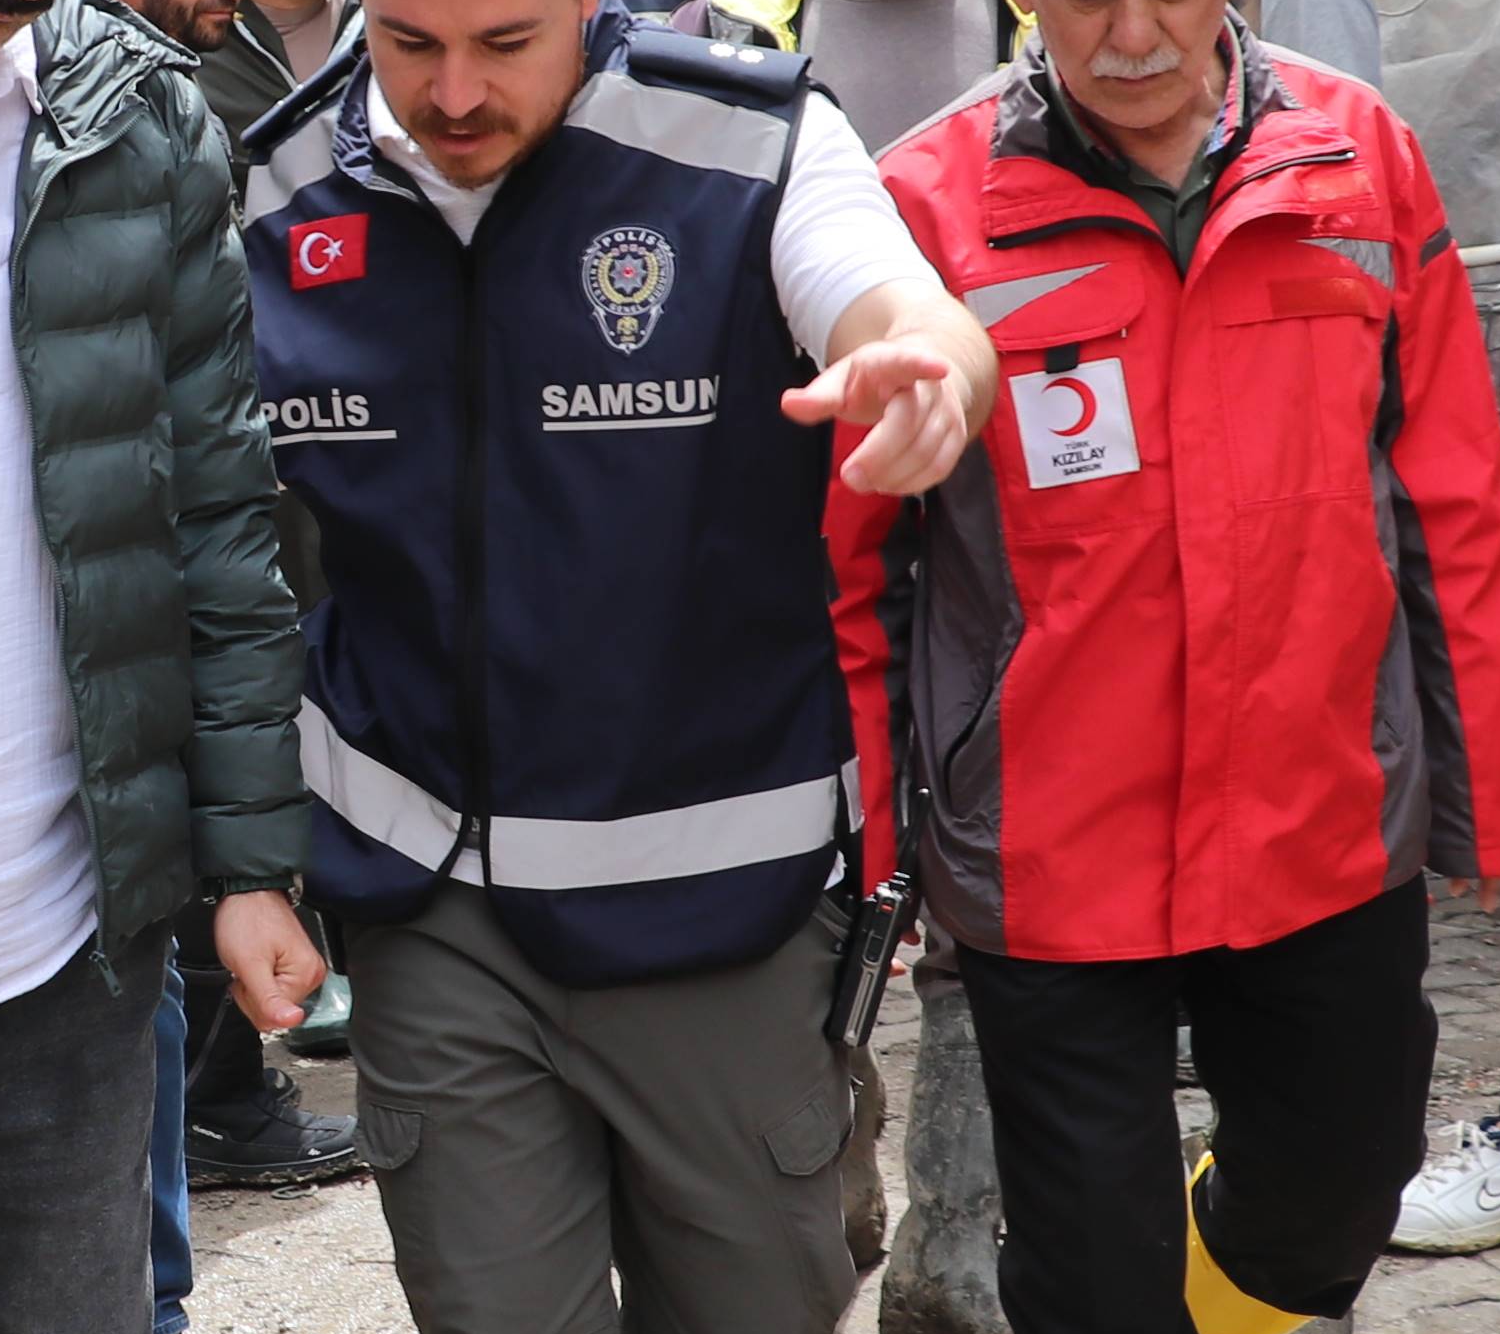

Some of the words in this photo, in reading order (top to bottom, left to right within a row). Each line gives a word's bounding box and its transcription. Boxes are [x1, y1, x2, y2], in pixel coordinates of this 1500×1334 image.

[601, 231, 657, 247] POLİS
[542, 375, 720, 418] SAMSUN
[260, 388, 370, 429] POLİS
[1051, 446, 1107, 467] KIZILAY
[1063, 463, 1102, 476] SAMSUN
